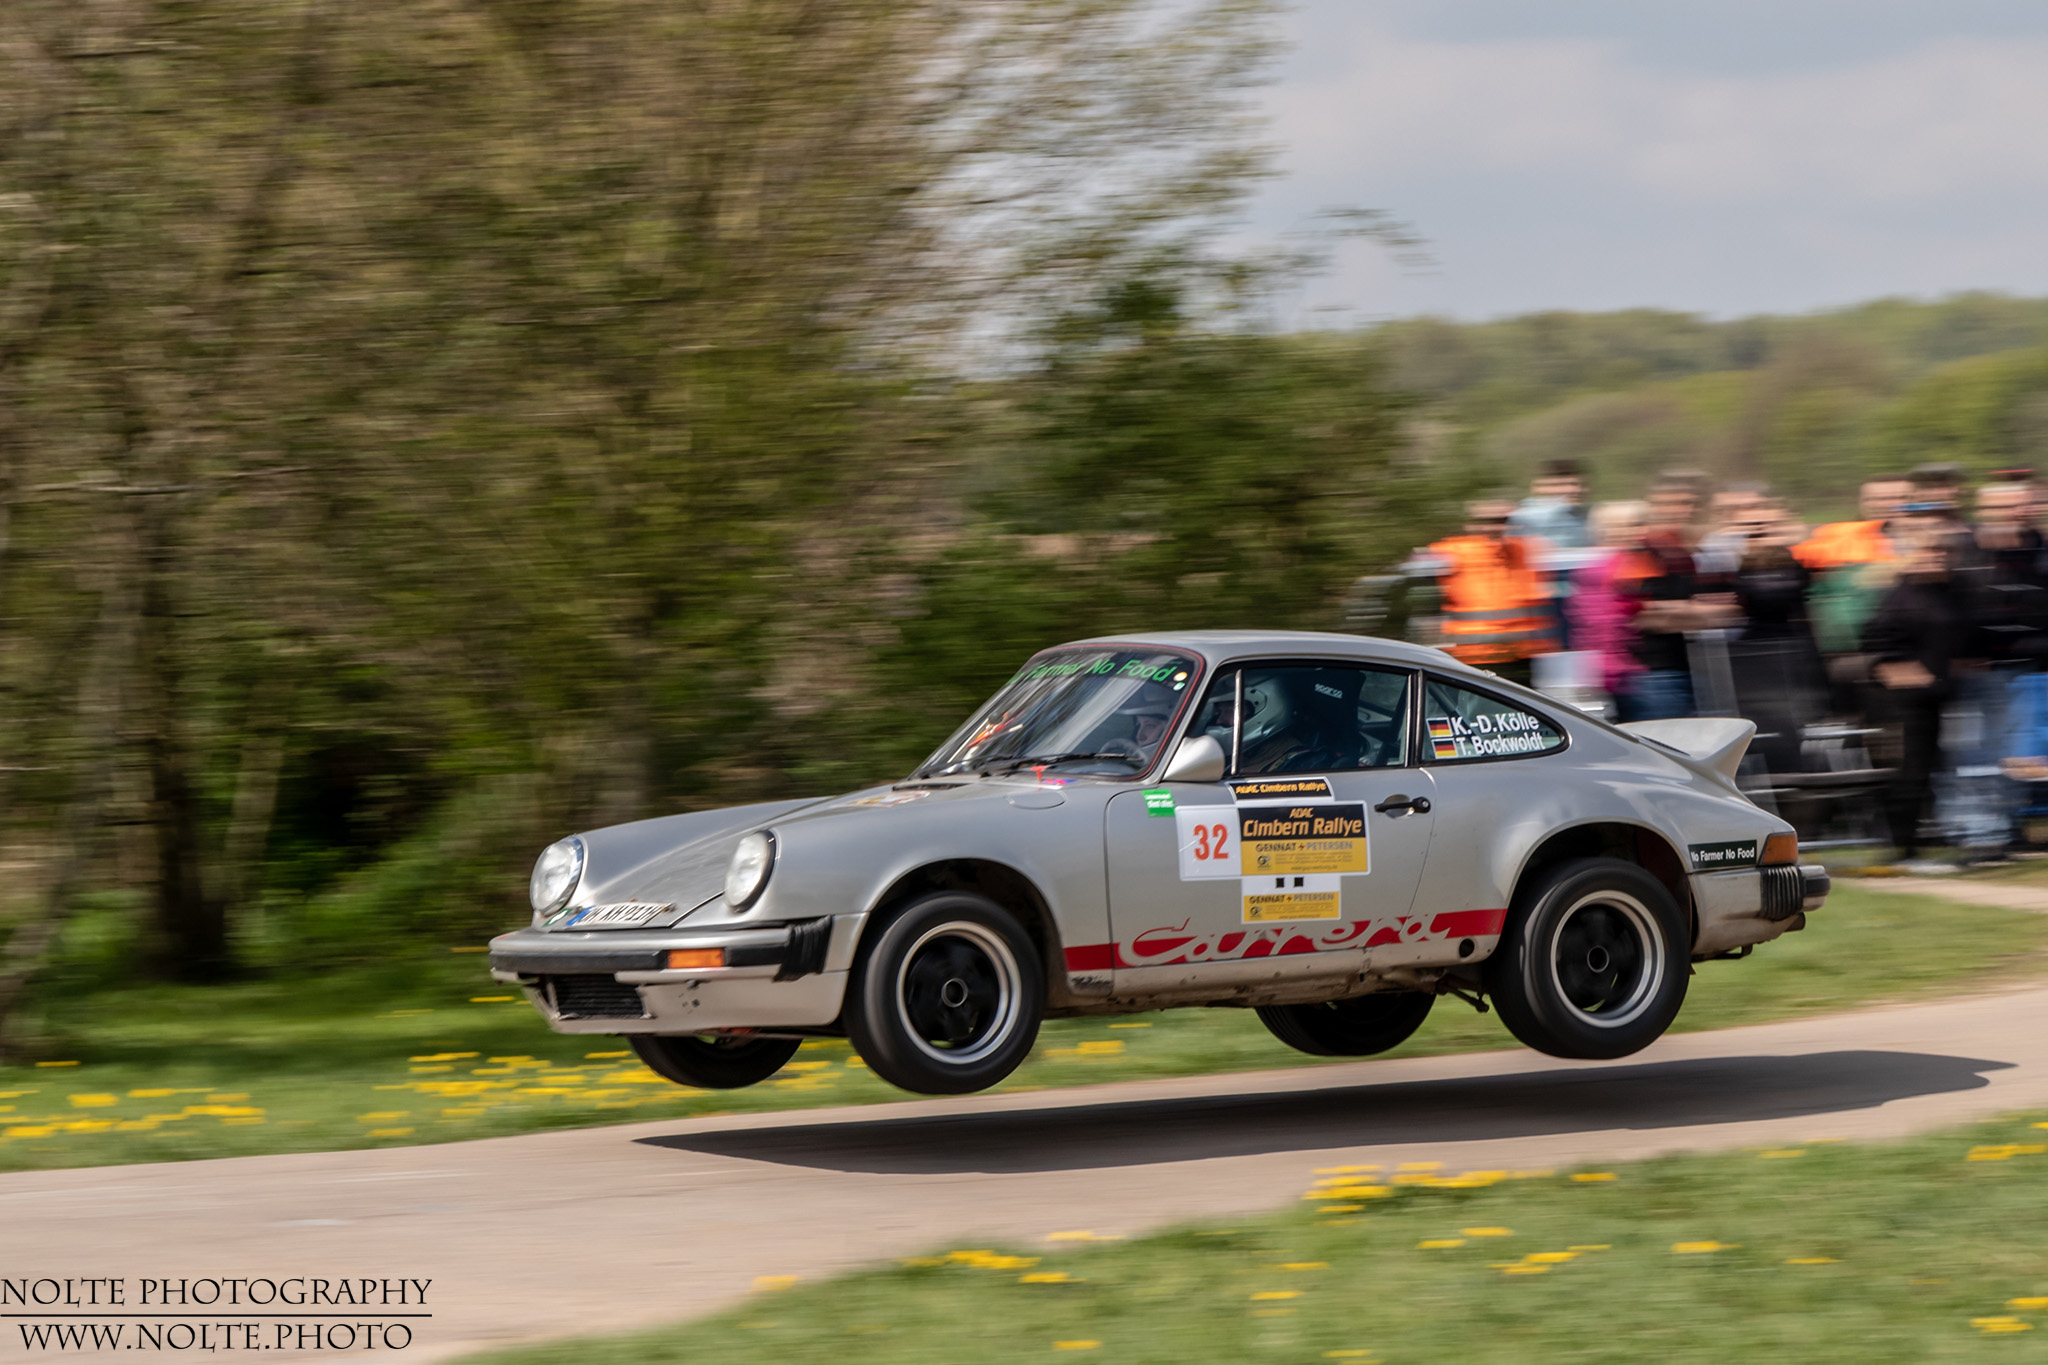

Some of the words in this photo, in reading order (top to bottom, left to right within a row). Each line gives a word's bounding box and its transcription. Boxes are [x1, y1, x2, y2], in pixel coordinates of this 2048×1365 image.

[1085, 659, 1116, 675] No
[1116, 659, 1178, 682] Food
[1457, 738, 1471, 755] T.
[1471, 732, 1546, 755] Bockwoldt
[1298, 782, 1327, 792] Rallye
[1289, 807, 1315, 819] ADAC
[1242, 818, 1309, 837] Cimbern
[1312, 816, 1363, 837] Rallye
[1193, 823, 1229, 861] 32
[1255, 842, 1296, 853] GENNAT
[1305, 840, 1353, 851] PETERSEN
[1700, 850, 1724, 861] Farmer
[1725, 848, 1736, 859] No
[1738, 847, 1755, 858] Food
[1293, 892, 1335, 902] PETERSEN
[1118, 913, 1452, 967] Carrera
